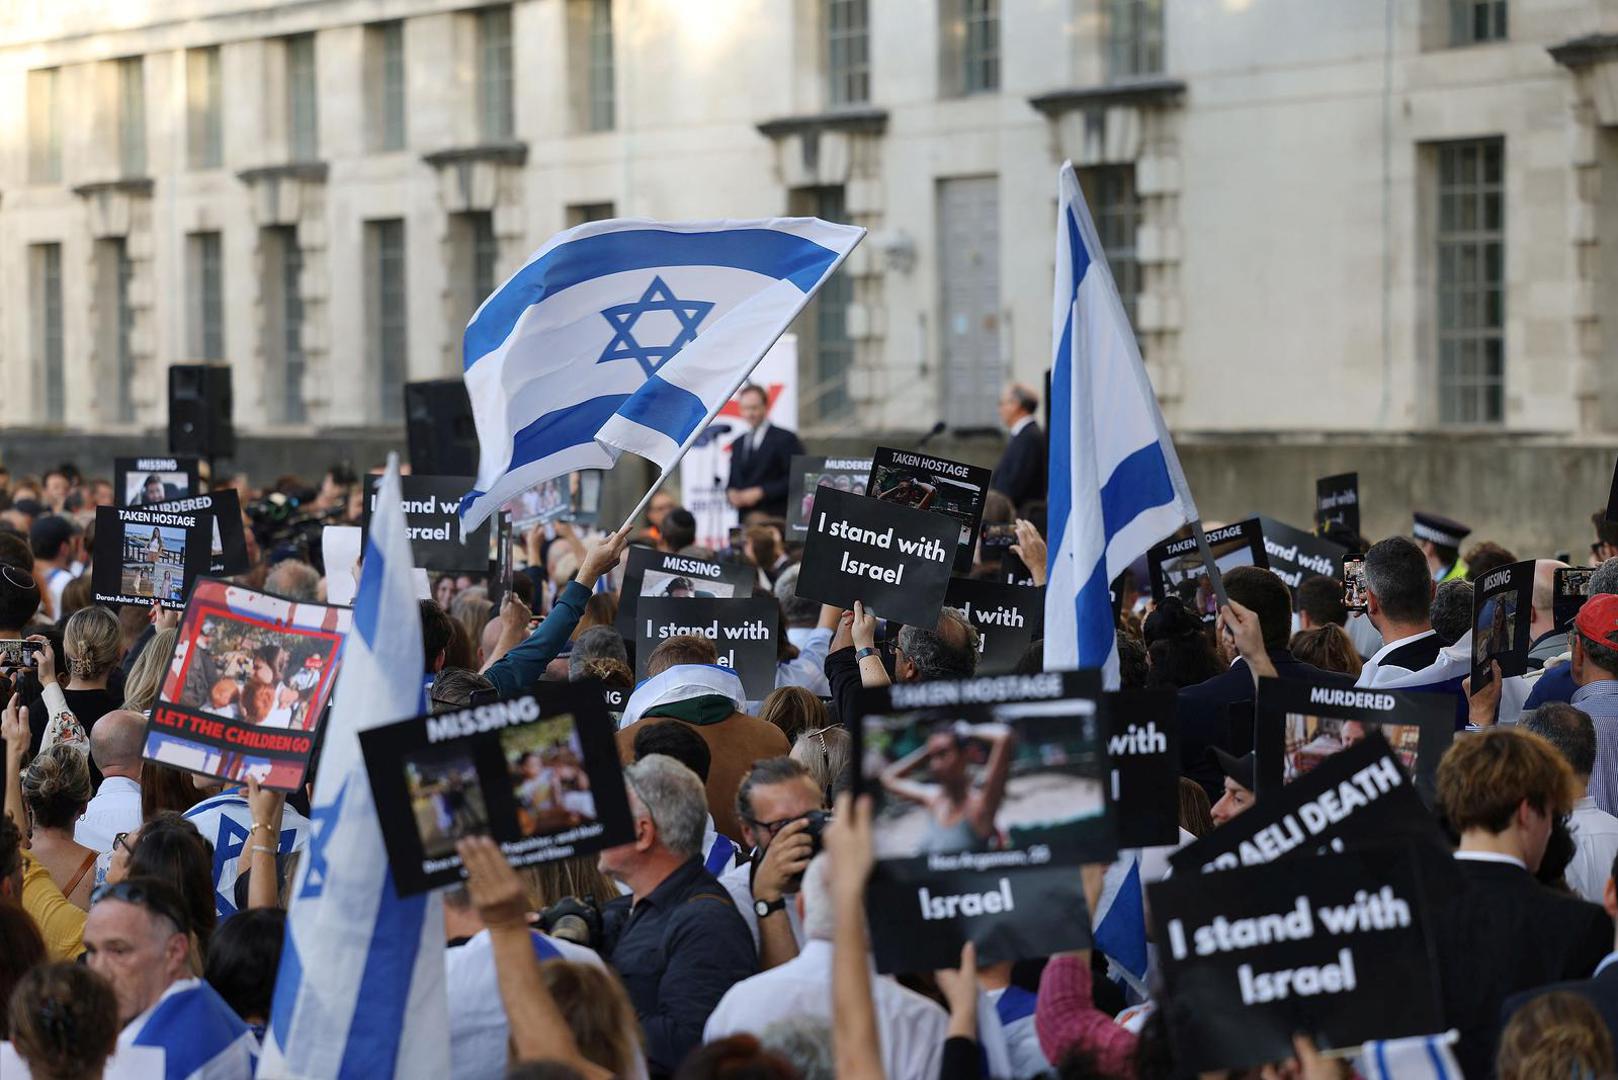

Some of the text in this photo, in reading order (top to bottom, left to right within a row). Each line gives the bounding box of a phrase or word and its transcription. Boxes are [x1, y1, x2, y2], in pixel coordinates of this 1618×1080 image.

[136, 458, 177, 471] MISSING
[892, 452, 969, 478] TAKEN HOSTAGE
[119, 510, 196, 527] TAKEN HOSTAGE
[401, 495, 435, 513] and
[404, 522, 450, 540] srael
[817, 512, 946, 563] I stand with
[1165, 525, 1242, 554] TAKEN OSTAGE
[662, 556, 721, 578] MISSING
[840, 551, 904, 585] Israel
[1263, 536, 1334, 577] and with
[1483, 569, 1511, 592] MISSING
[646, 619, 769, 640] I stand with
[975, 606, 1024, 628] with
[1310, 687, 1395, 710] MURDERED
[155, 708, 311, 753] LET THE CHILDREN GO
[426, 696, 540, 743] MISSING
[1107, 721, 1167, 755] with
[1202, 756, 1402, 874] AELI DEATH
[918, 877, 1015, 920] Israel
[1168, 884, 1411, 961] I stand with
[1237, 947, 1357, 1006] Israel
